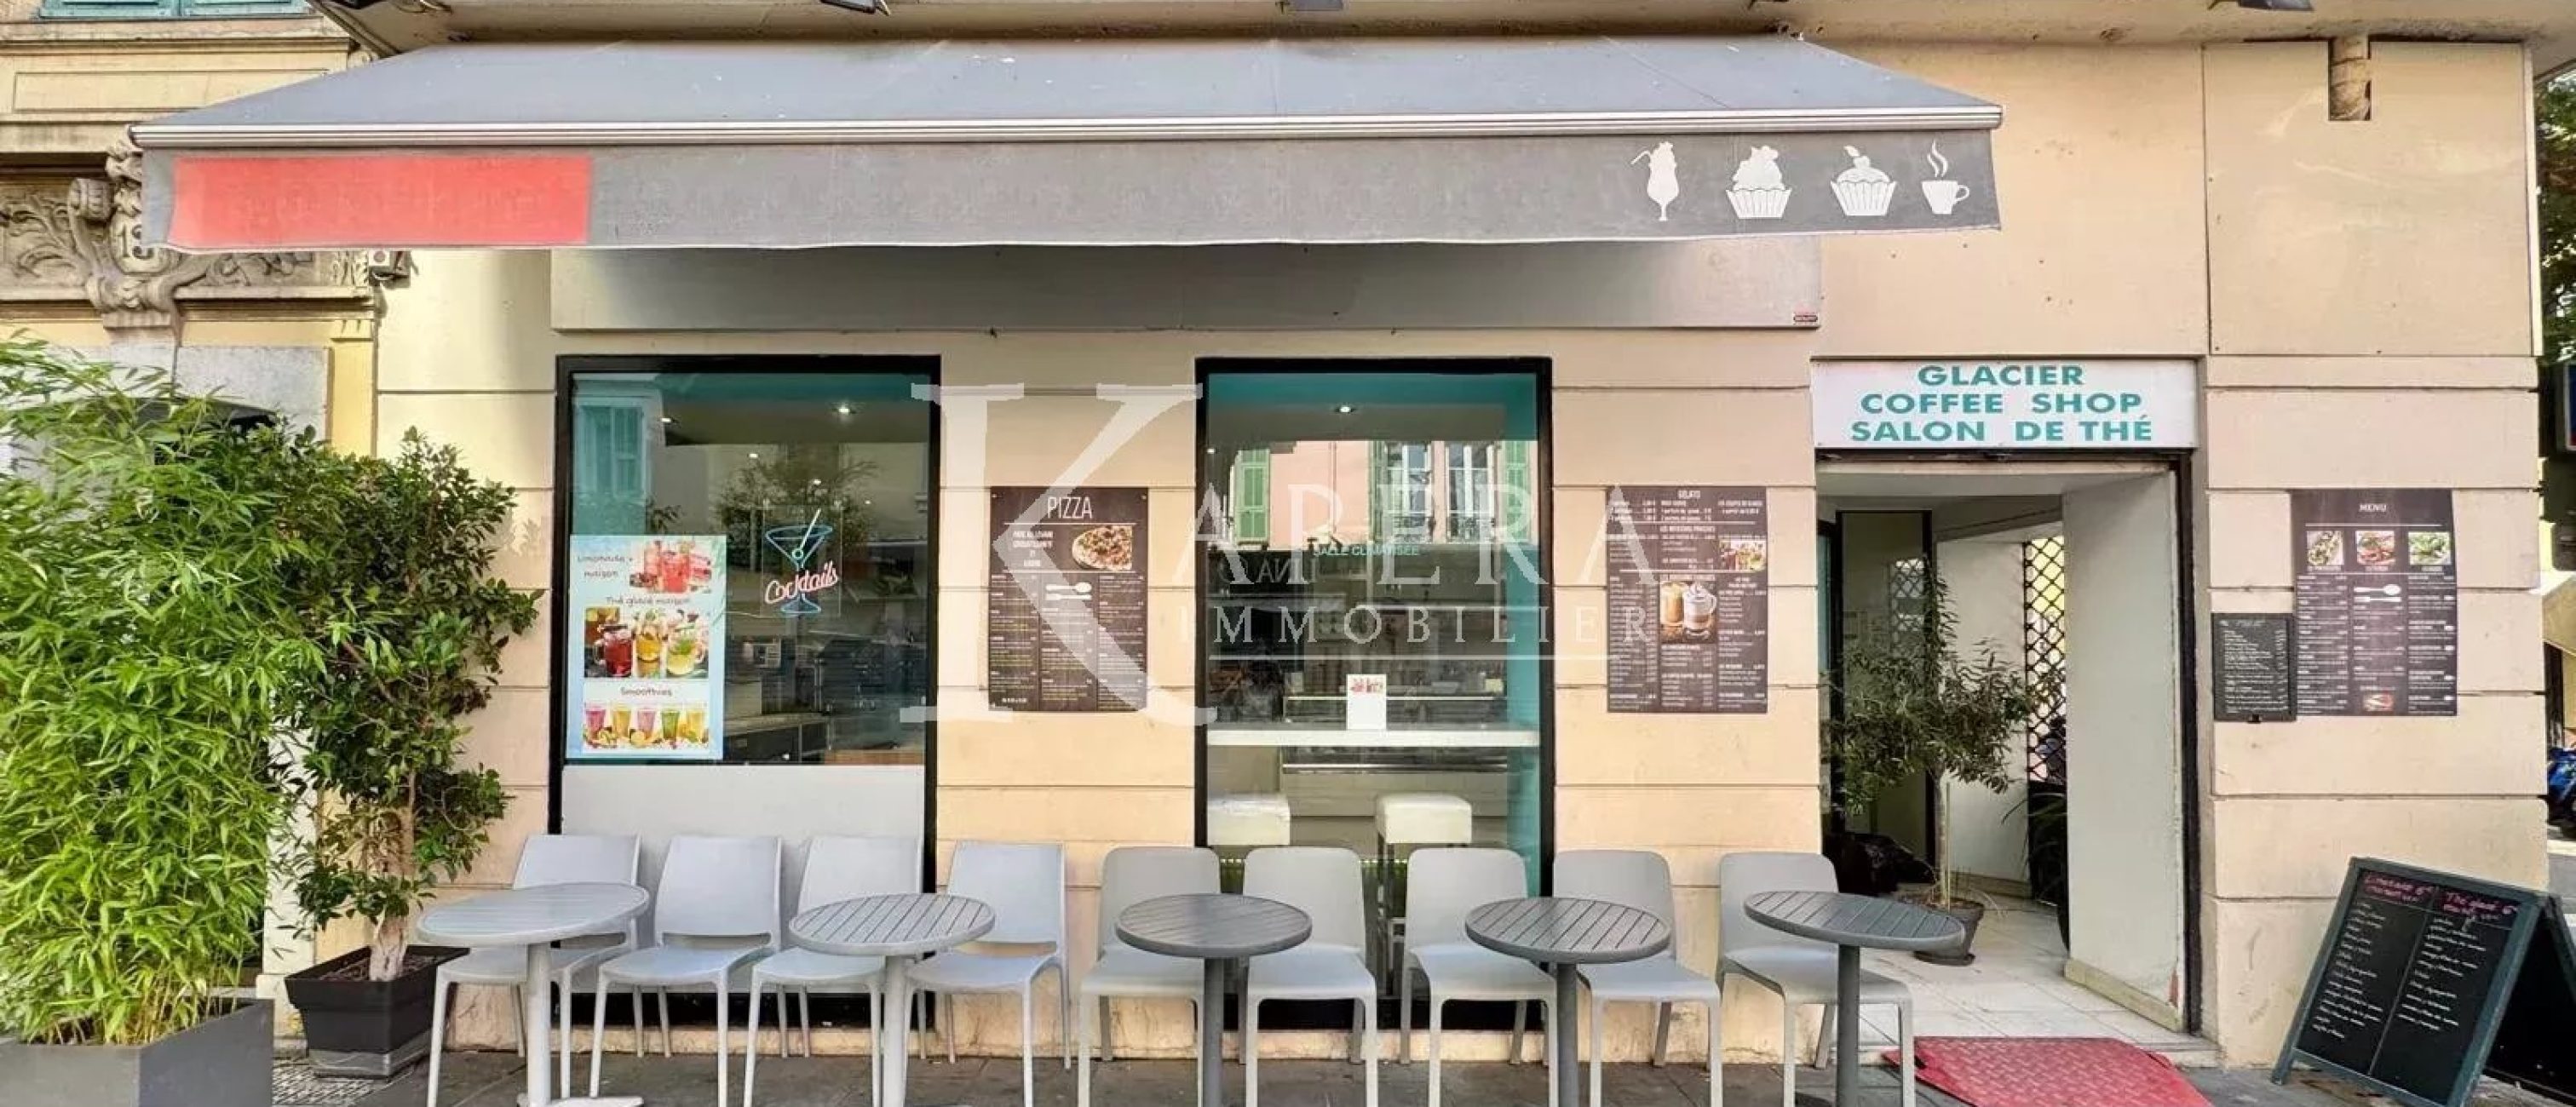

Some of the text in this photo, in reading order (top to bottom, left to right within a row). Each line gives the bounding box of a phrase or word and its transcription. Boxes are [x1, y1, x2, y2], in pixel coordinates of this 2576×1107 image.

[1917, 364, 2084, 387] GLACIER
[1860, 393, 2142, 414] COFFEE SHOP
[1851, 414, 2153, 442] SALON DE THÉ
[1047, 496, 1093, 519] PIZZA
[2359, 503, 2387, 513] MENU
[765, 559, 838, 604] Cocktails
[621, 686, 673, 697] Smoothies
